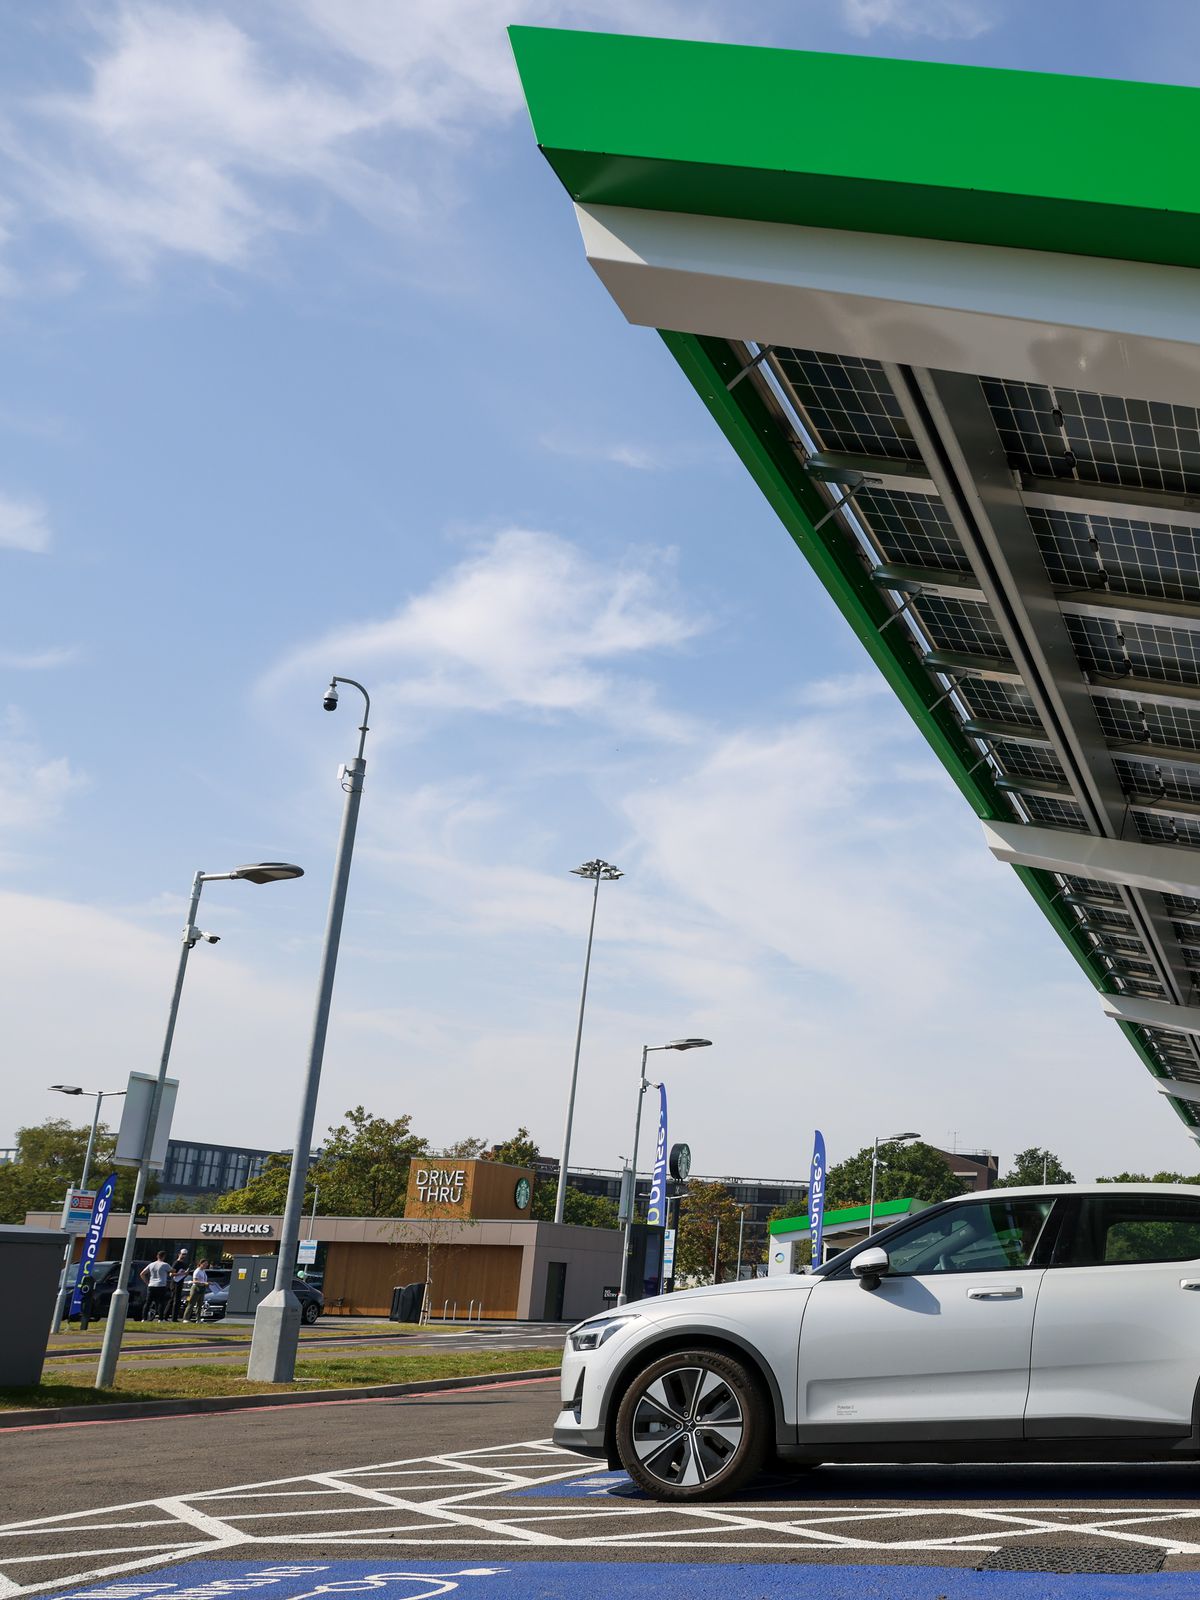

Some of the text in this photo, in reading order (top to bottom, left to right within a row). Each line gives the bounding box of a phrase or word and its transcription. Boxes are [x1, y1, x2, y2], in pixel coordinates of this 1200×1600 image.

[416, 1169, 465, 1186] DRIVE
[418, 1186, 462, 1203] THRU
[87, 1198, 107, 1259] pulse
[200, 1223, 270, 1233] STARBUCKS
